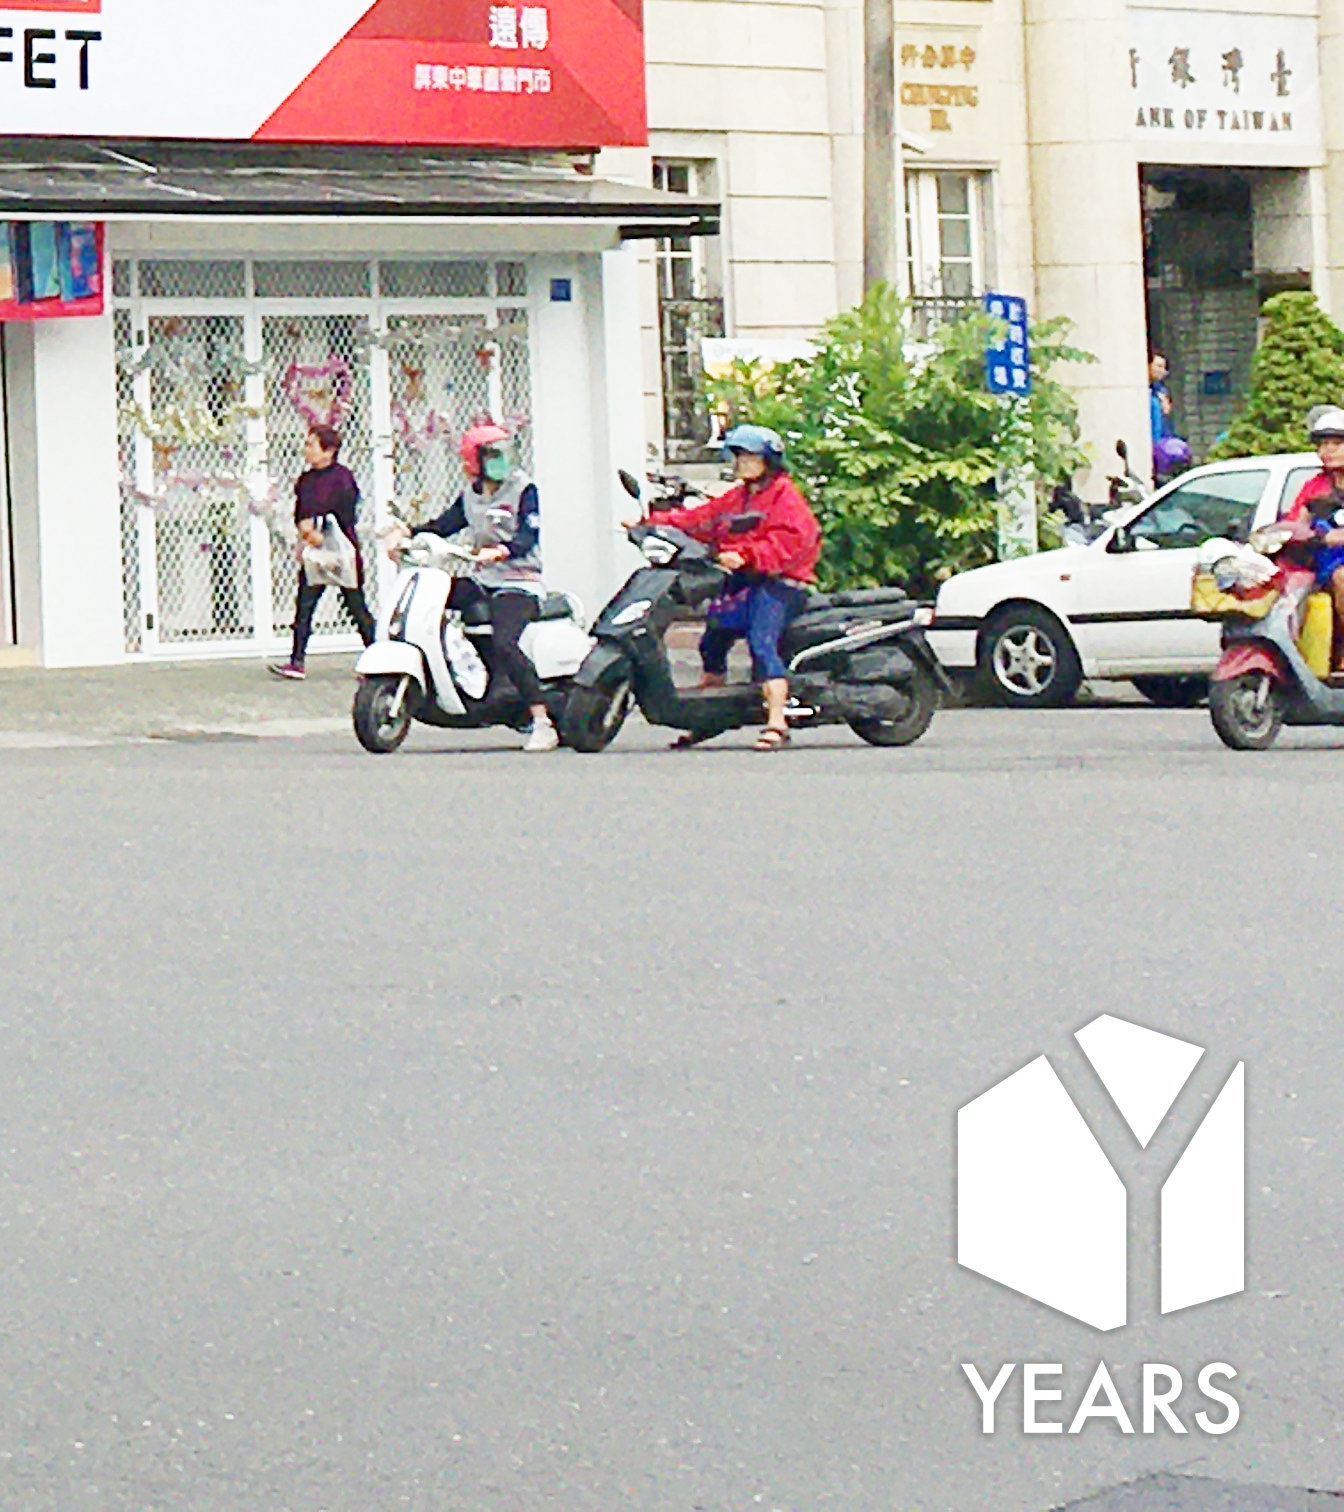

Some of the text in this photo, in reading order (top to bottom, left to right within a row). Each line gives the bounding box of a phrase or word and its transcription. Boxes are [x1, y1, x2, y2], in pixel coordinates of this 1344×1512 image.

[488, 5, 550, 51] 遠傳
[1136, 106, 1294, 131] ANK OF TAIWAN
